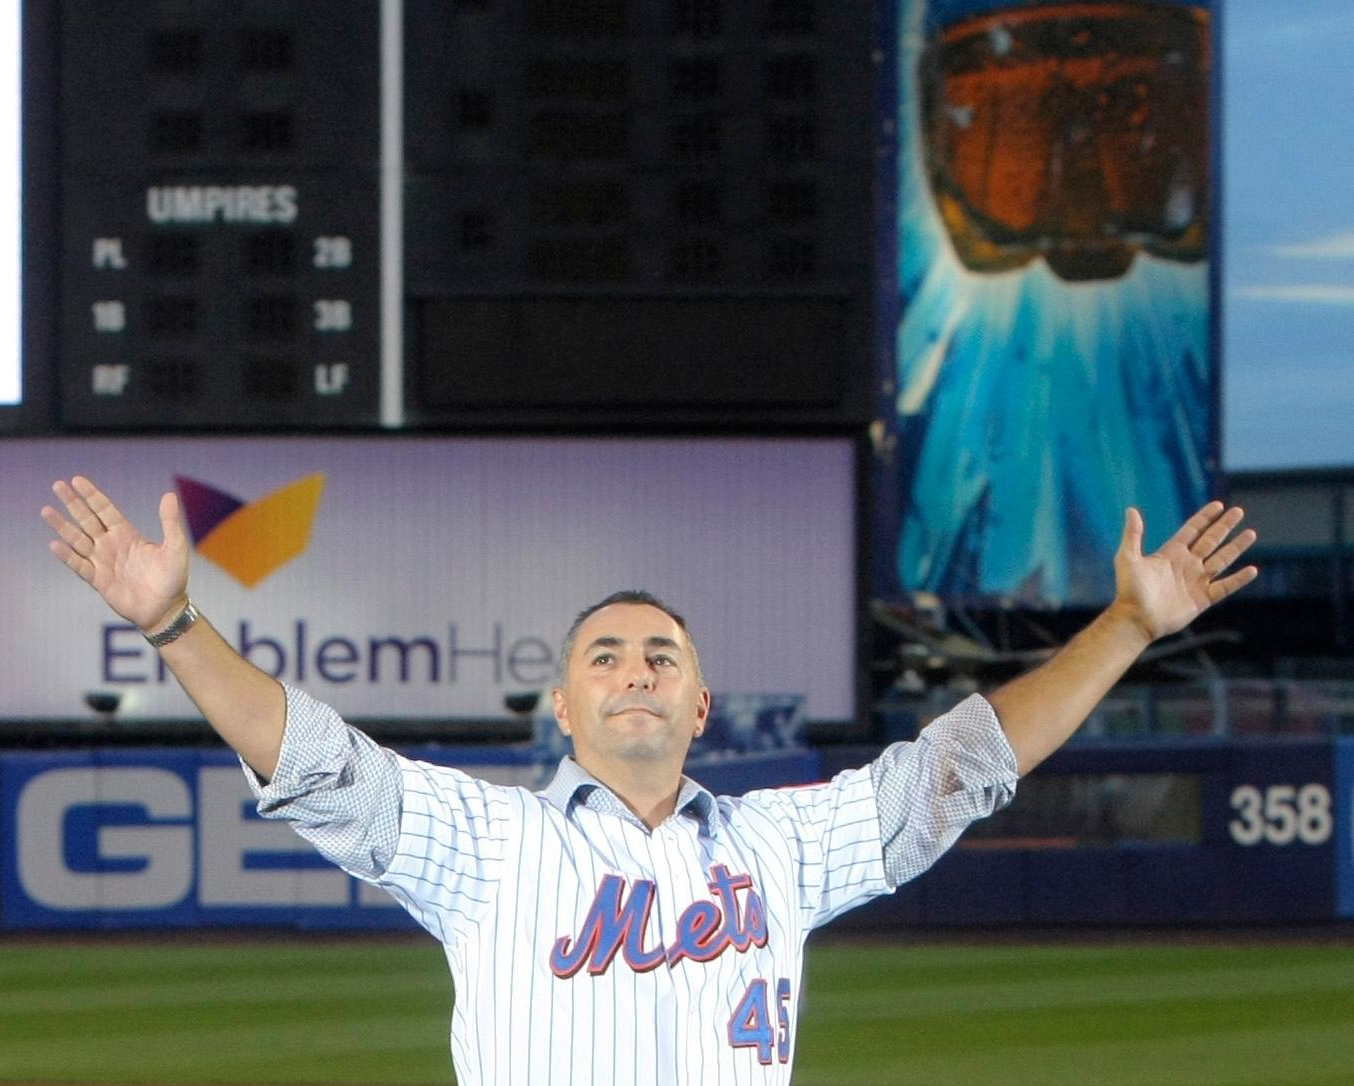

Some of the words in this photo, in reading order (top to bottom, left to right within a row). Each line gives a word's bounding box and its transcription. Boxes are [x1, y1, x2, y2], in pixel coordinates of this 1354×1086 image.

[147, 185, 298, 223] UMPIRES
[1228, 782, 1334, 846] 358
[549, 863, 769, 979] Mets
[727, 977, 791, 1065] 45
